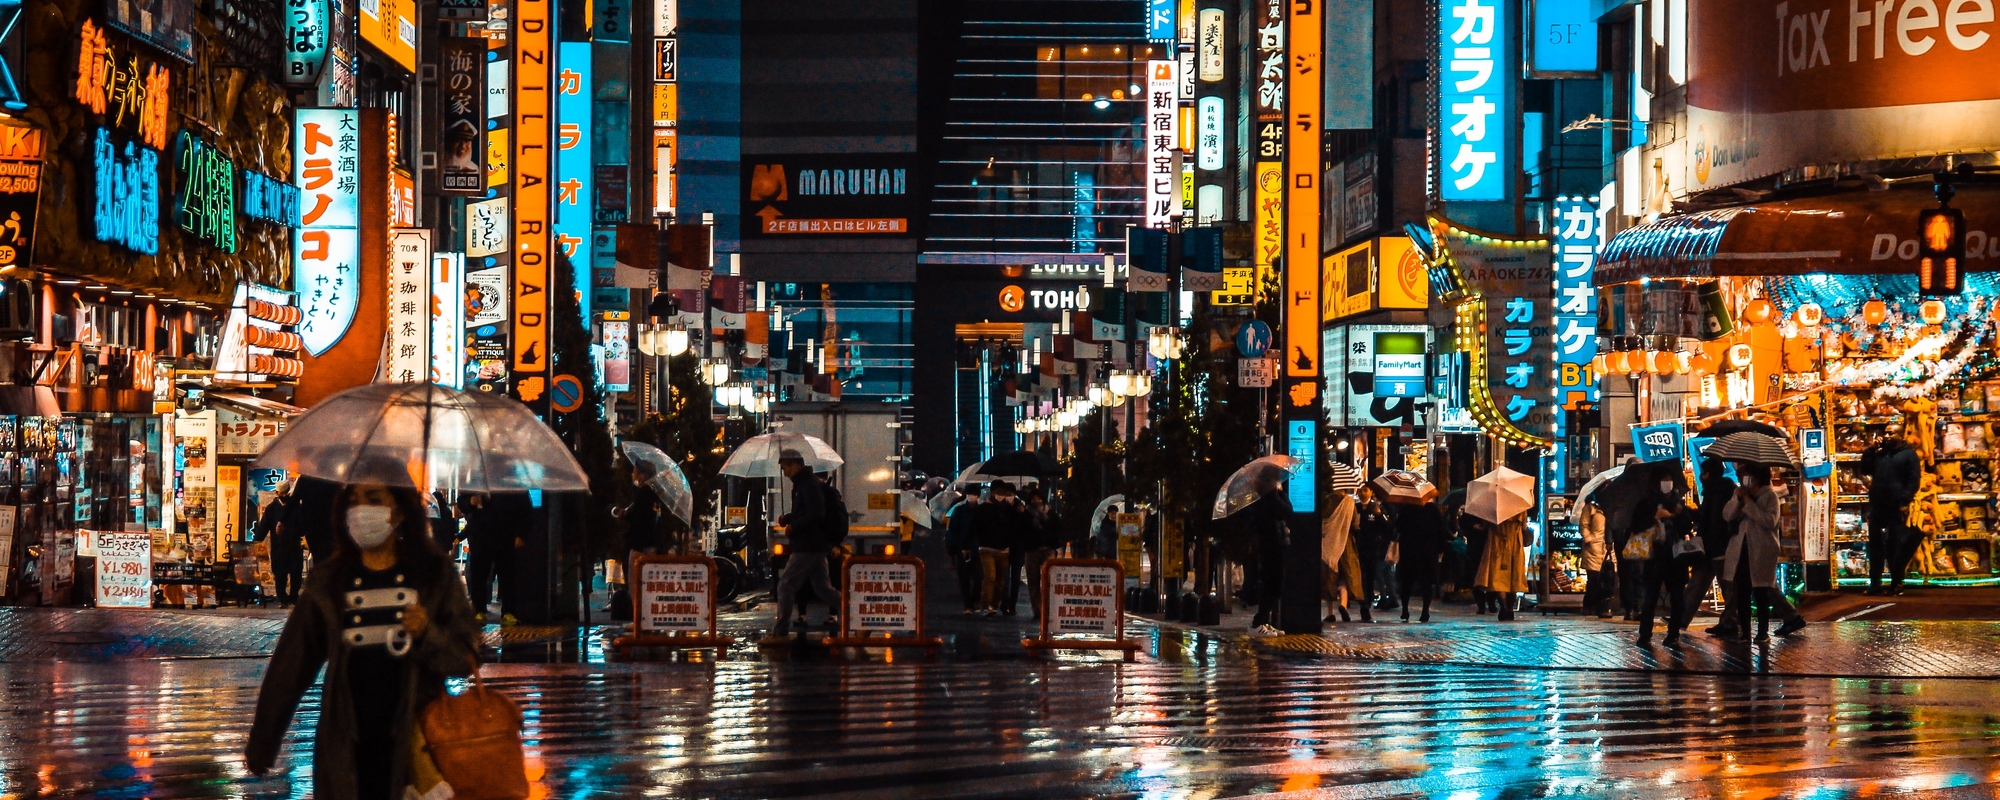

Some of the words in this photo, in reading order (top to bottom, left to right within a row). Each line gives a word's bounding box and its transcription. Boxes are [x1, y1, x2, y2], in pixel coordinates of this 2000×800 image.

[1153, 0, 1171, 30] ド
[1549, 24, 1582, 44] 5F
[1776, 1, 1831, 78] Tax
[1849, 0, 1995, 63] Free
[292, 62, 313, 75] B1
[450, 50, 473, 115] 海の家
[663, 41, 674, 72] ダーツ
[522, 0, 544, 189] DZILLA
[1450, 0, 1496, 191] カラオケ
[337, 113, 356, 195] 大衆酒場
[799, 169, 906, 195] MARUHAN
[181, 131, 236, 255] 24時間
[301, 122, 333, 262] トラノコ
[558, 69, 583, 304] カラオケ
[520, 220, 542, 327] ROAD
[1871, 233, 1920, 260] Do
[303, 274, 329, 333] やきとん
[326, 262, 350, 320] やきとり
[1560, 205, 1595, 355] カラオケ
[1378, 360, 1422, 369] FamilyMart
[1393, 382, 1406, 395] 酒
[1504, 297, 1536, 422] カラオケ
[1561, 363, 1593, 386] B1
[222, 422, 276, 437] トラノコ
[99, 534, 114, 547] 5F
